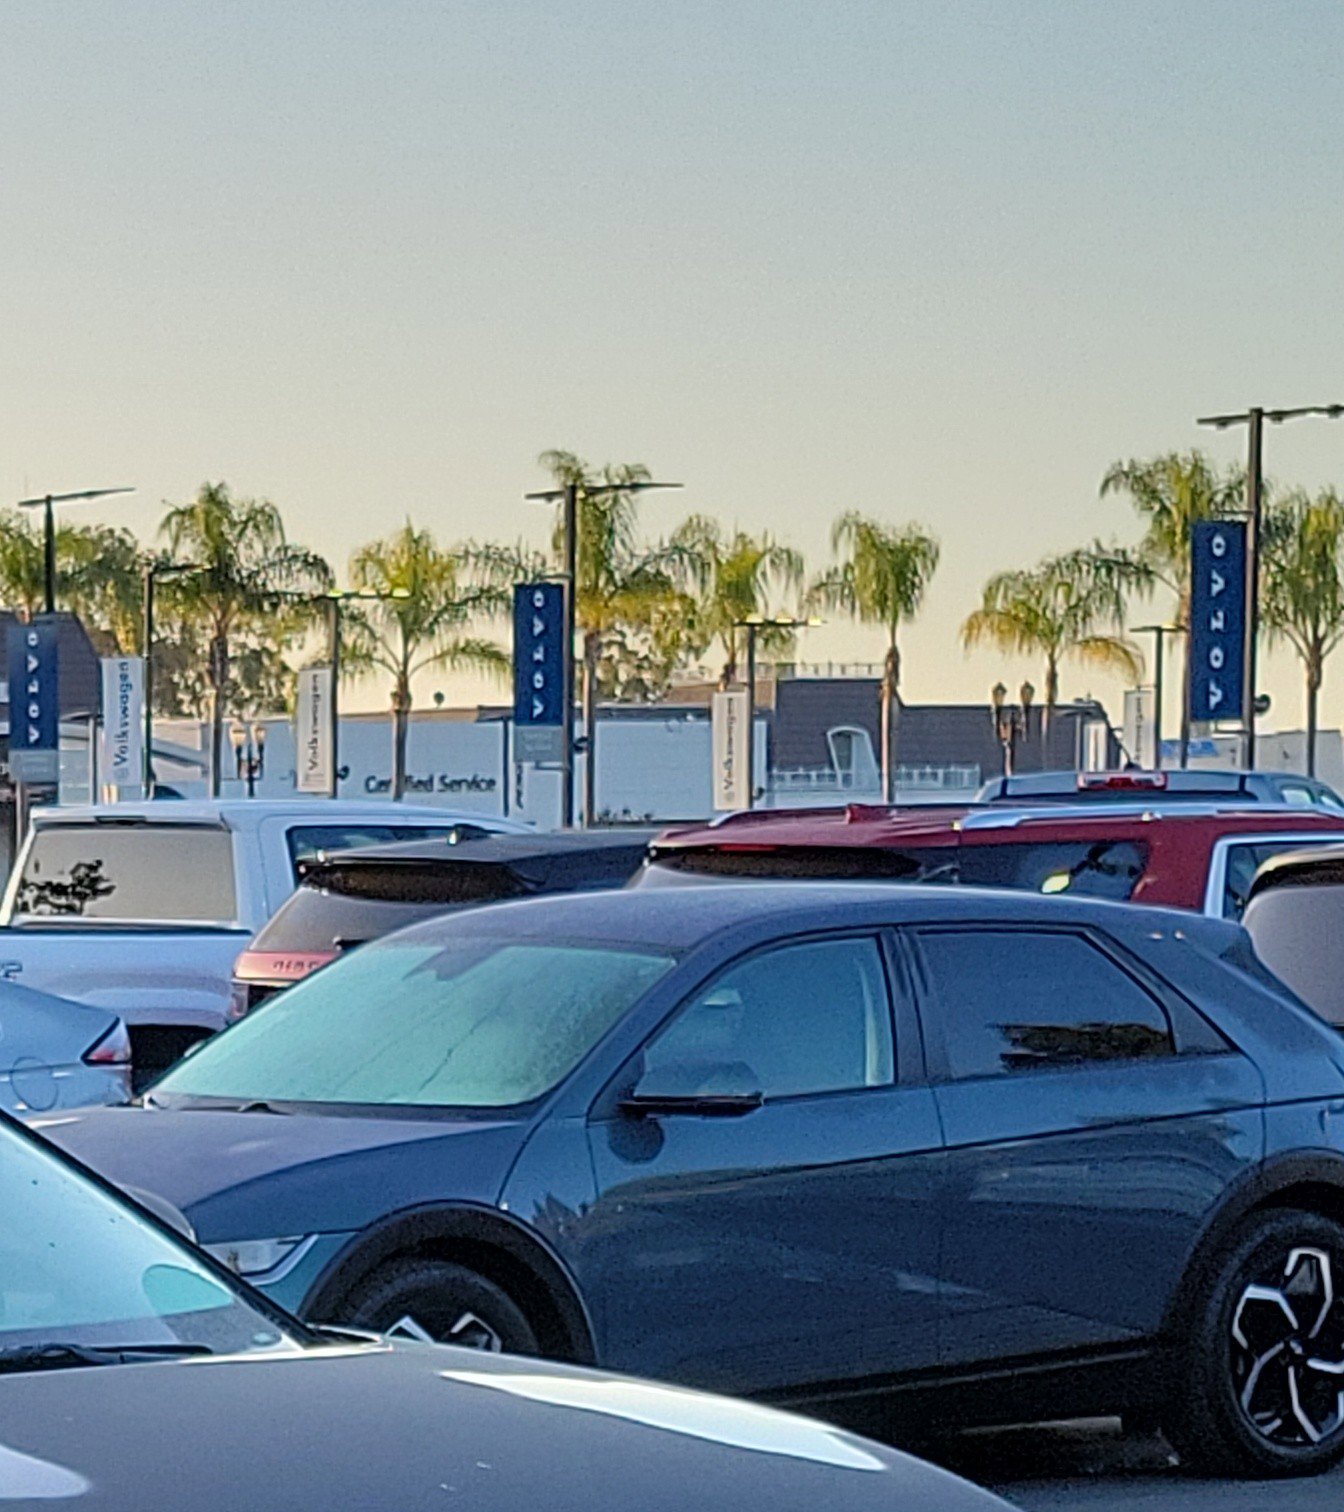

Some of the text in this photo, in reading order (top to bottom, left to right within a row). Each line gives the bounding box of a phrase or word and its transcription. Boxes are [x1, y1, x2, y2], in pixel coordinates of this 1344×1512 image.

[532, 589, 545, 719] VOLVO
[1209, 533, 1226, 710] VOLVO
[26, 631, 41, 744] VOLVO
[113, 660, 132, 767] Volkswagen
[438, 774, 496, 793] Service
